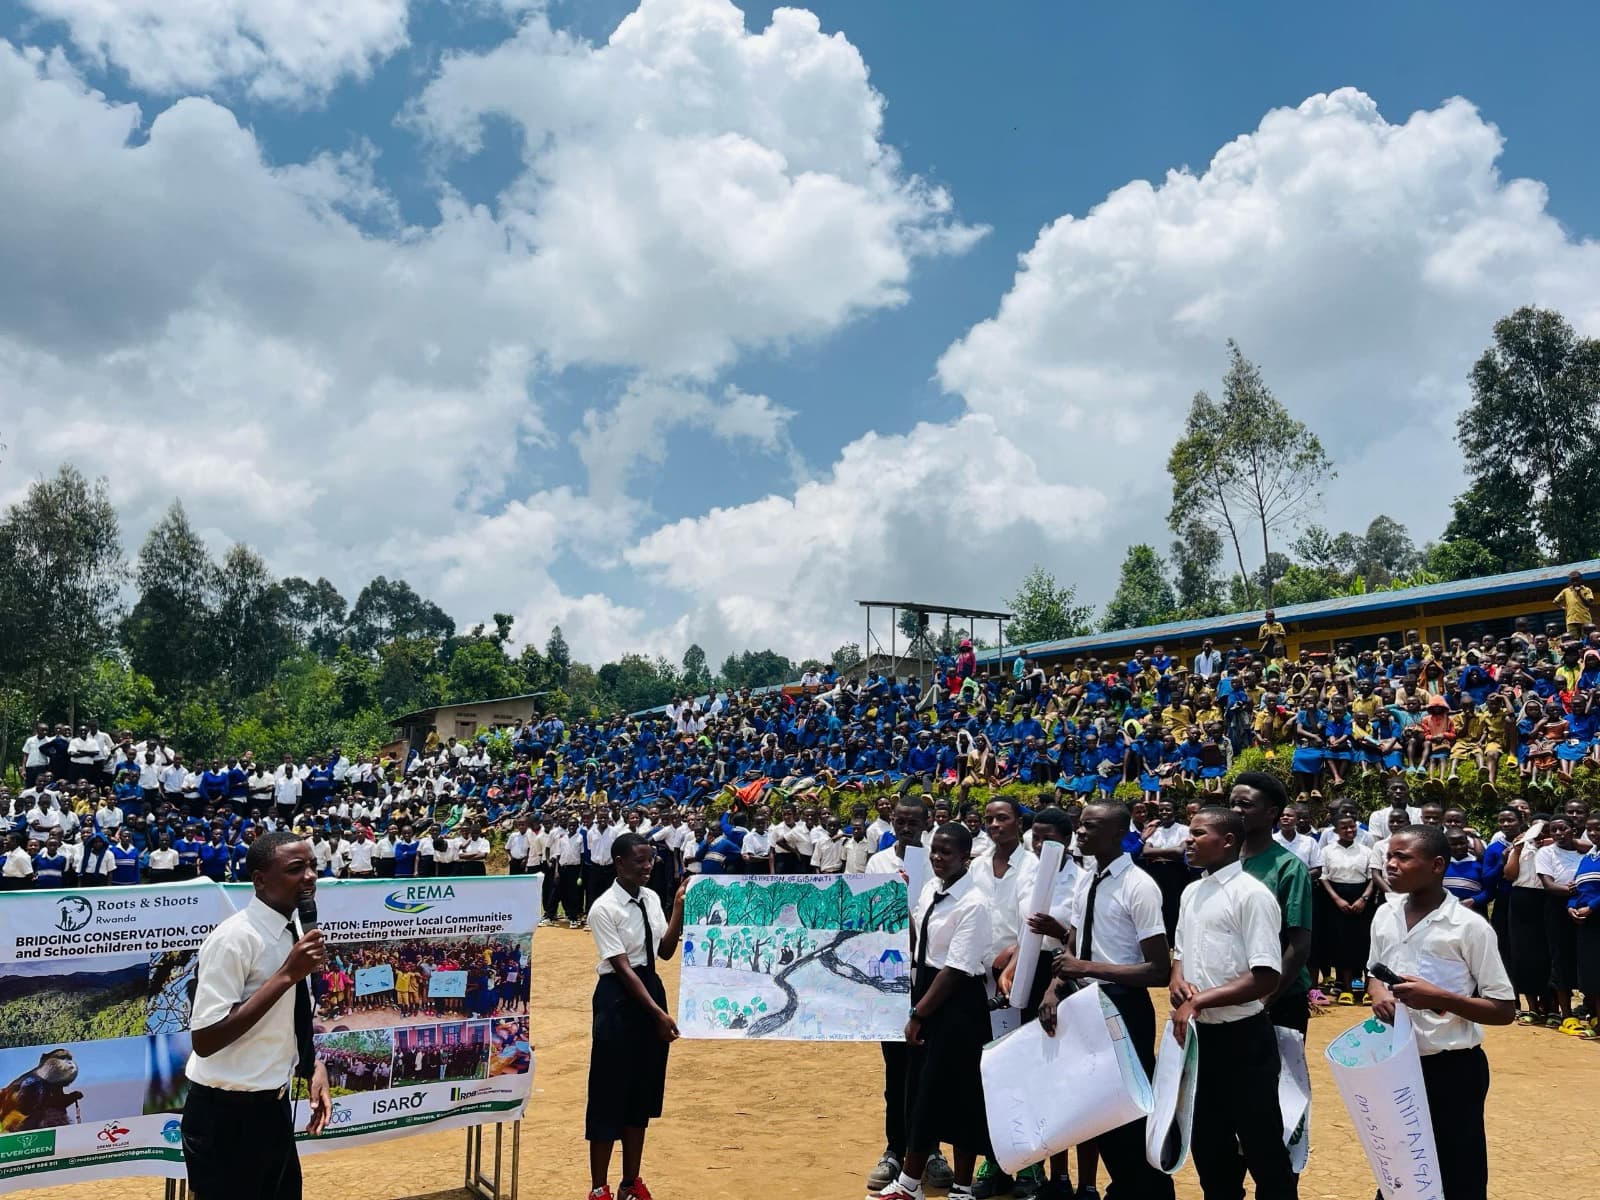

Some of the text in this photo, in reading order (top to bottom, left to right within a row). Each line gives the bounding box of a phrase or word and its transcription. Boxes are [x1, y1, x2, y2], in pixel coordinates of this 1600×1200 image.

[407, 885, 455, 900] REMA
[97, 896, 199, 911] Roots & Shoots
[96, 914, 137, 924] Rwanda
[317, 912, 513, 931] CATION: Empower Local Communities
[16, 924, 218, 947] BRIDGING CONSERVATION, COM
[331, 929, 388, 940] Protecting
[391, 927, 416, 937] their
[418, 925, 456, 936] Natural
[459, 923, 504, 934] Heritage.
[16, 938, 205, 959] and Schoolchildren to becom
[461, 1090, 477, 1100] RDB
[373, 1093, 424, 1115] ISARO
[1, 1145, 53, 1158] EVERGREEN
